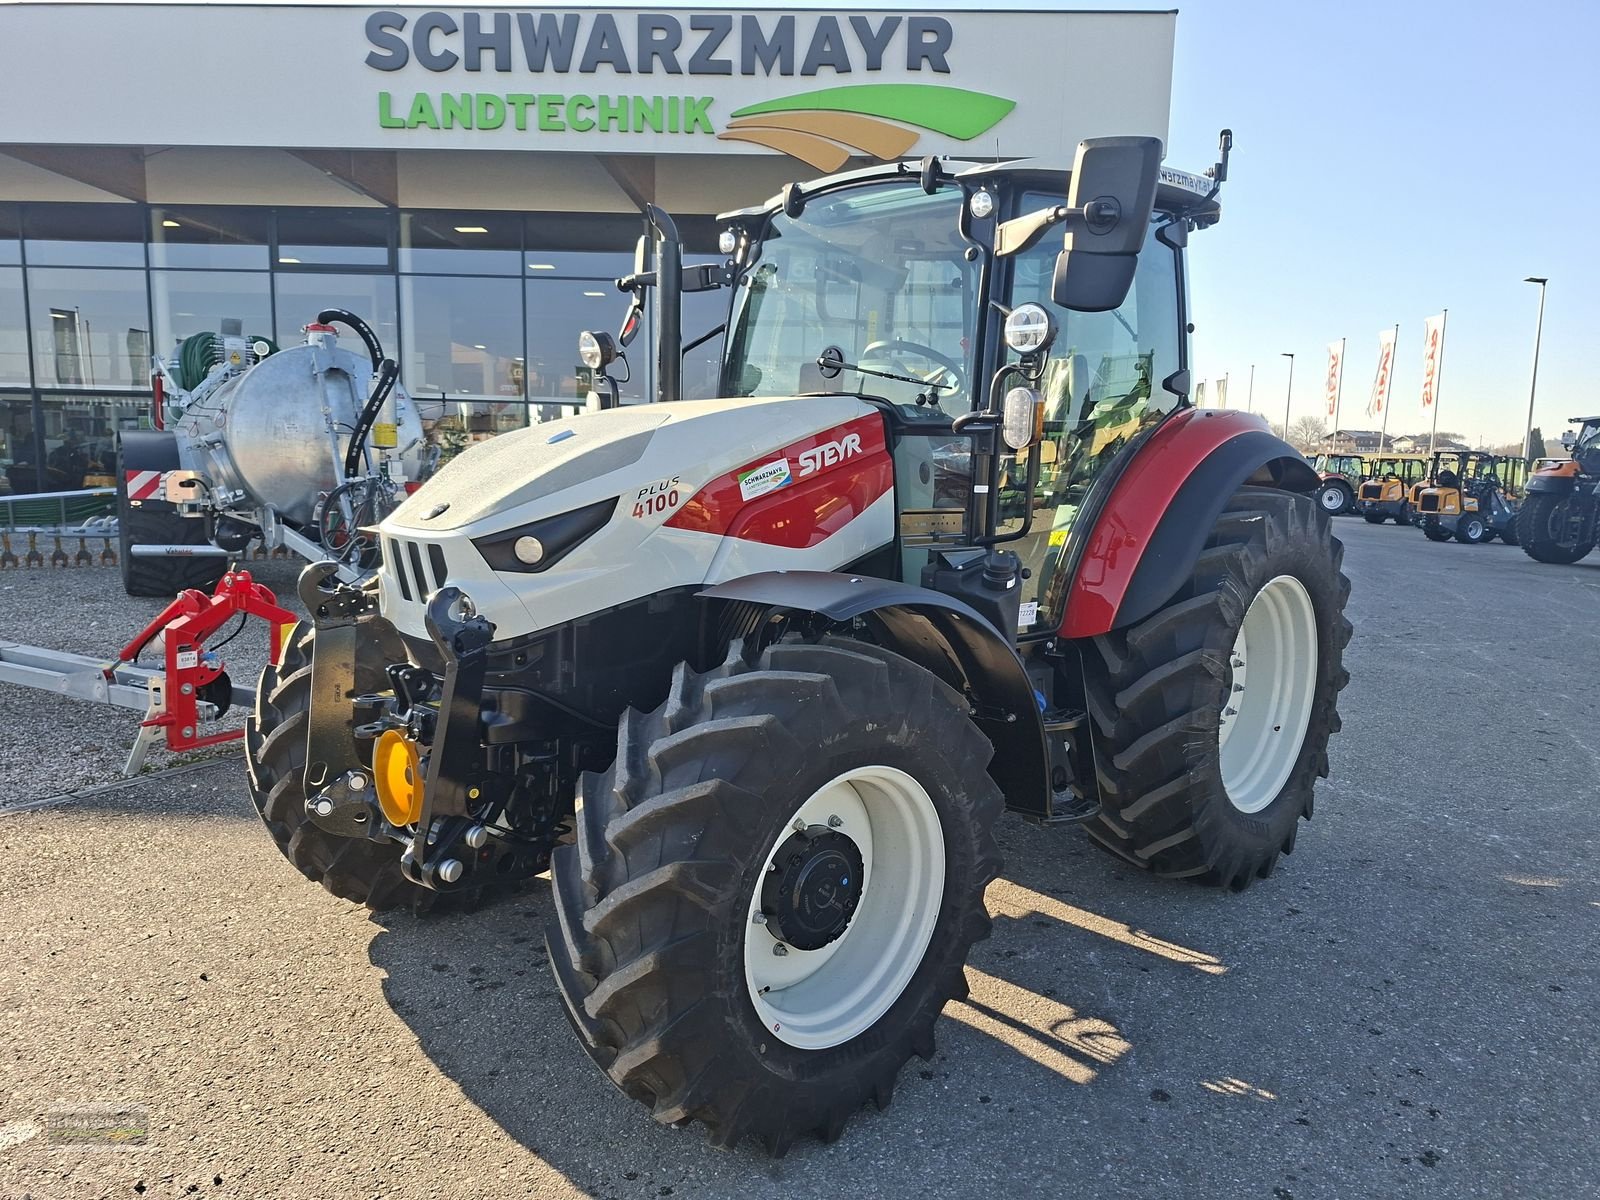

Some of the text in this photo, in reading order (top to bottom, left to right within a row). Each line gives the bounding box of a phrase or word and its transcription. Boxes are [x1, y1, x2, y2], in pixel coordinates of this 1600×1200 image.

[365, 11, 953, 76] SCHWARZMAYR
[379, 91, 715, 134] LANDTECHNIK
[1159, 170, 1211, 192] warzmayr.at
[799, 433, 863, 477] STEYR
[637, 475, 680, 500] PLUS
[744, 466, 783, 486] SCHWARZMAYR
[632, 490, 679, 518] 4100
